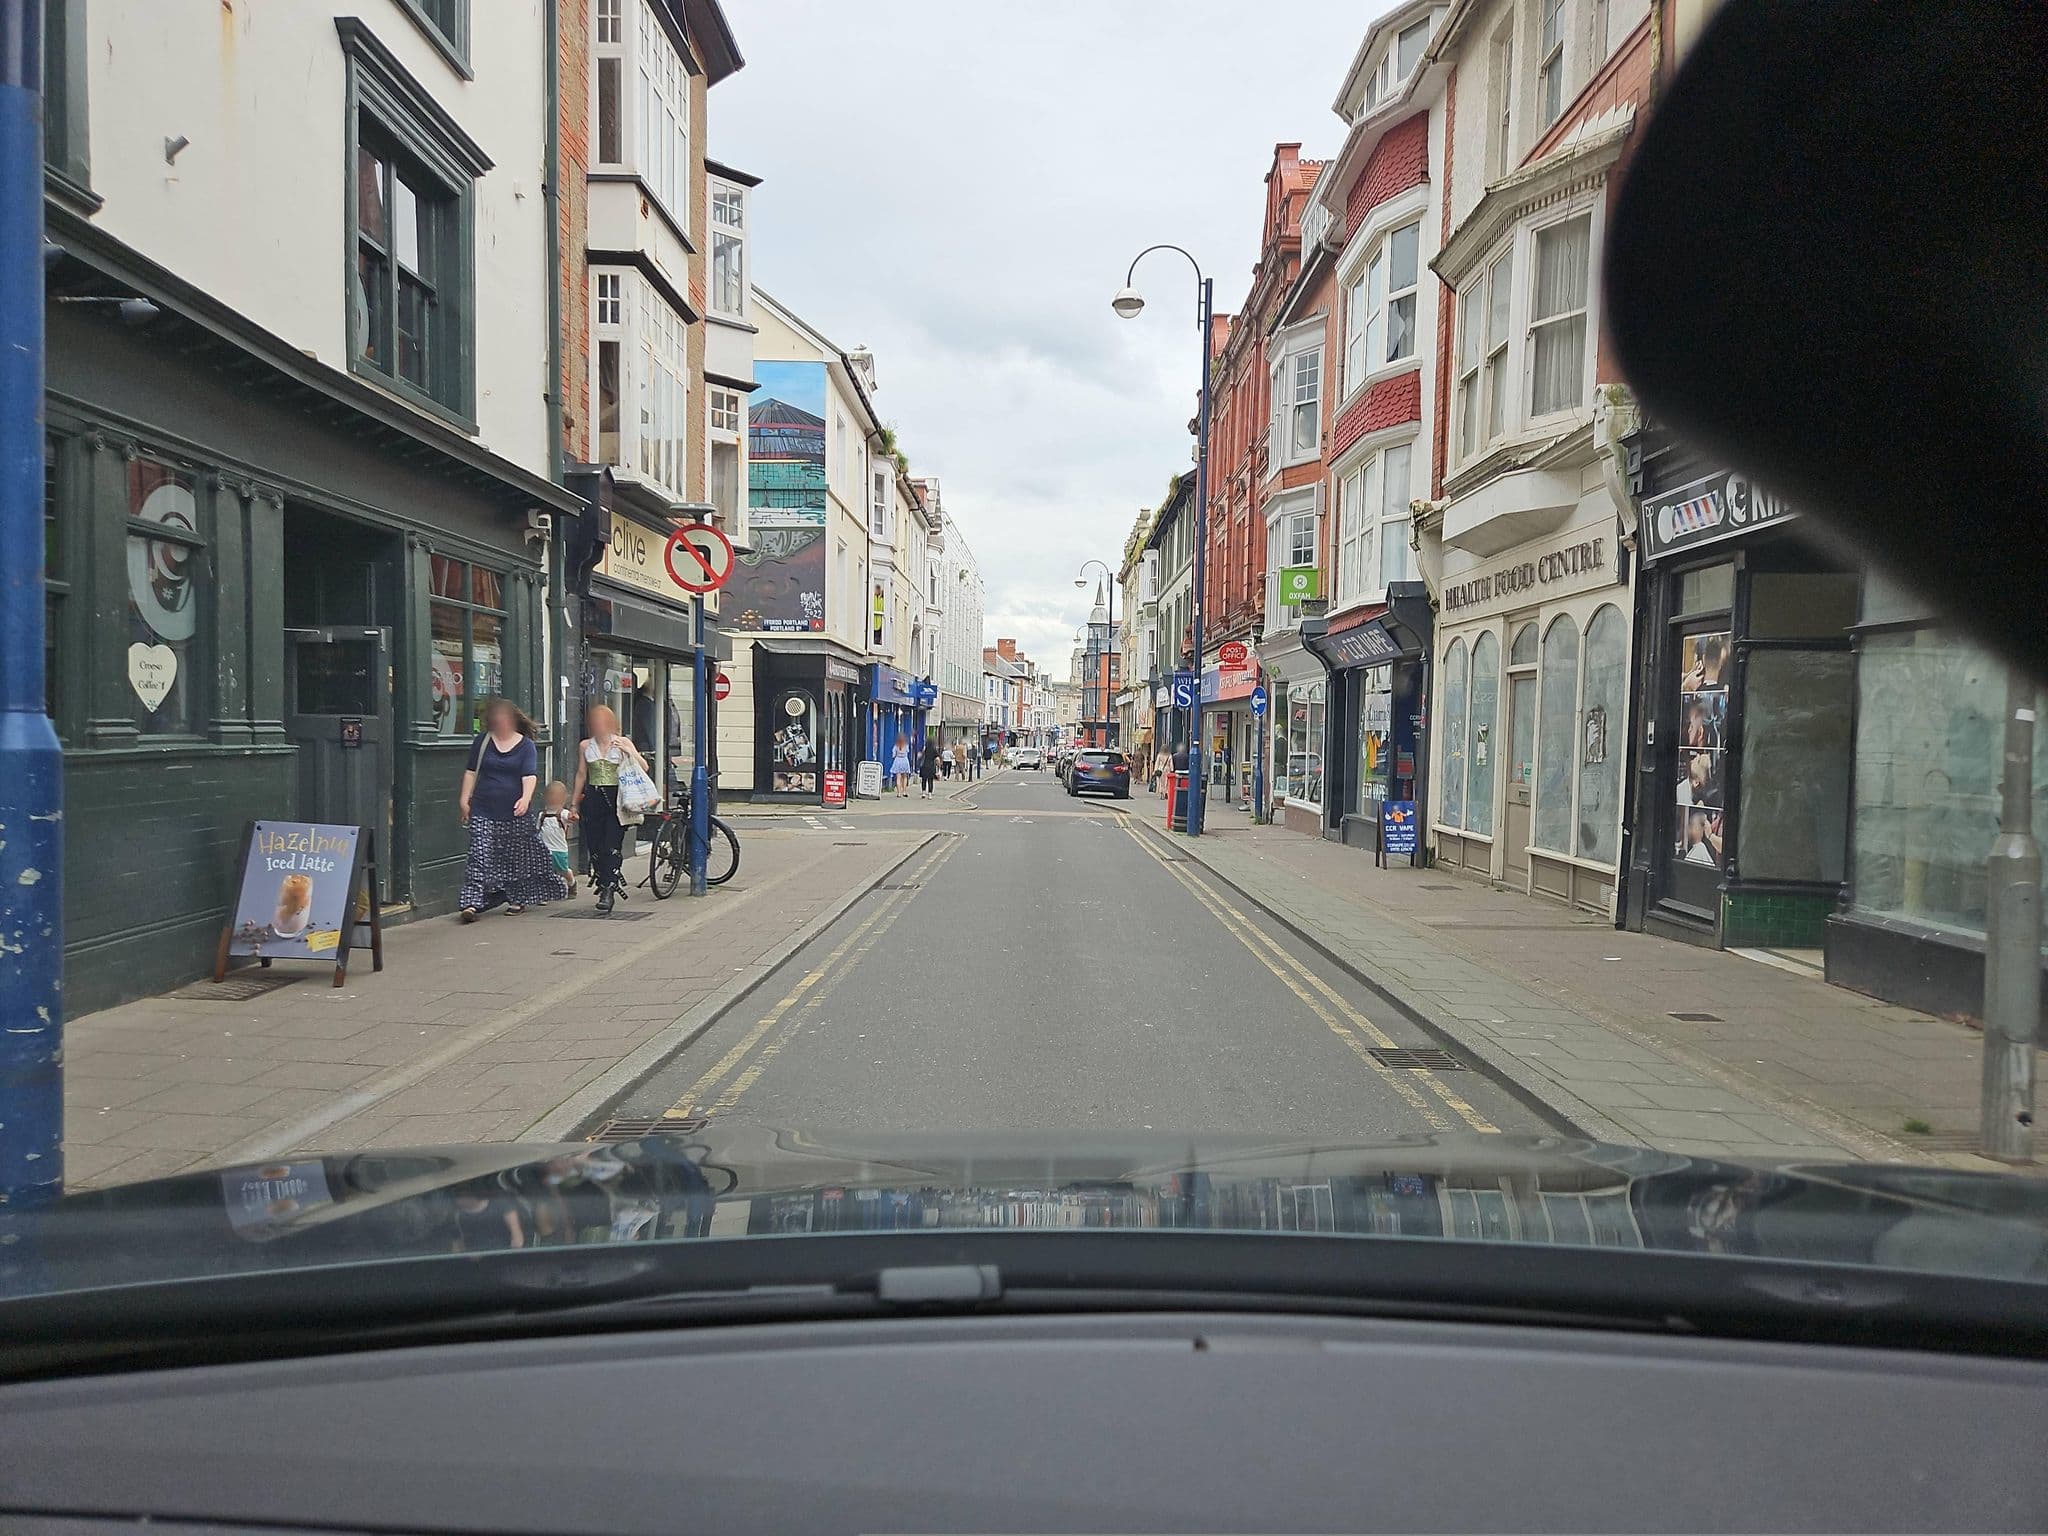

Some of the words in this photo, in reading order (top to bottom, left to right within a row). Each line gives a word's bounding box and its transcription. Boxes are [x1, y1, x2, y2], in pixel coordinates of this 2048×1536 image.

[613, 520, 646, 566] clive
[1445, 575, 1491, 612] HEALTH
[1494, 562, 1536, 598] FOOD
[1538, 537, 1604, 584] CENTRE
[1288, 592, 1311, 600] OXFAM
[804, 609, 823, 619] 2022
[1357, 629, 1394, 656] VAPE
[1176, 684, 1192, 707] S
[1399, 824, 1414, 832] VAPE
[265, 853, 296, 872] Iced
